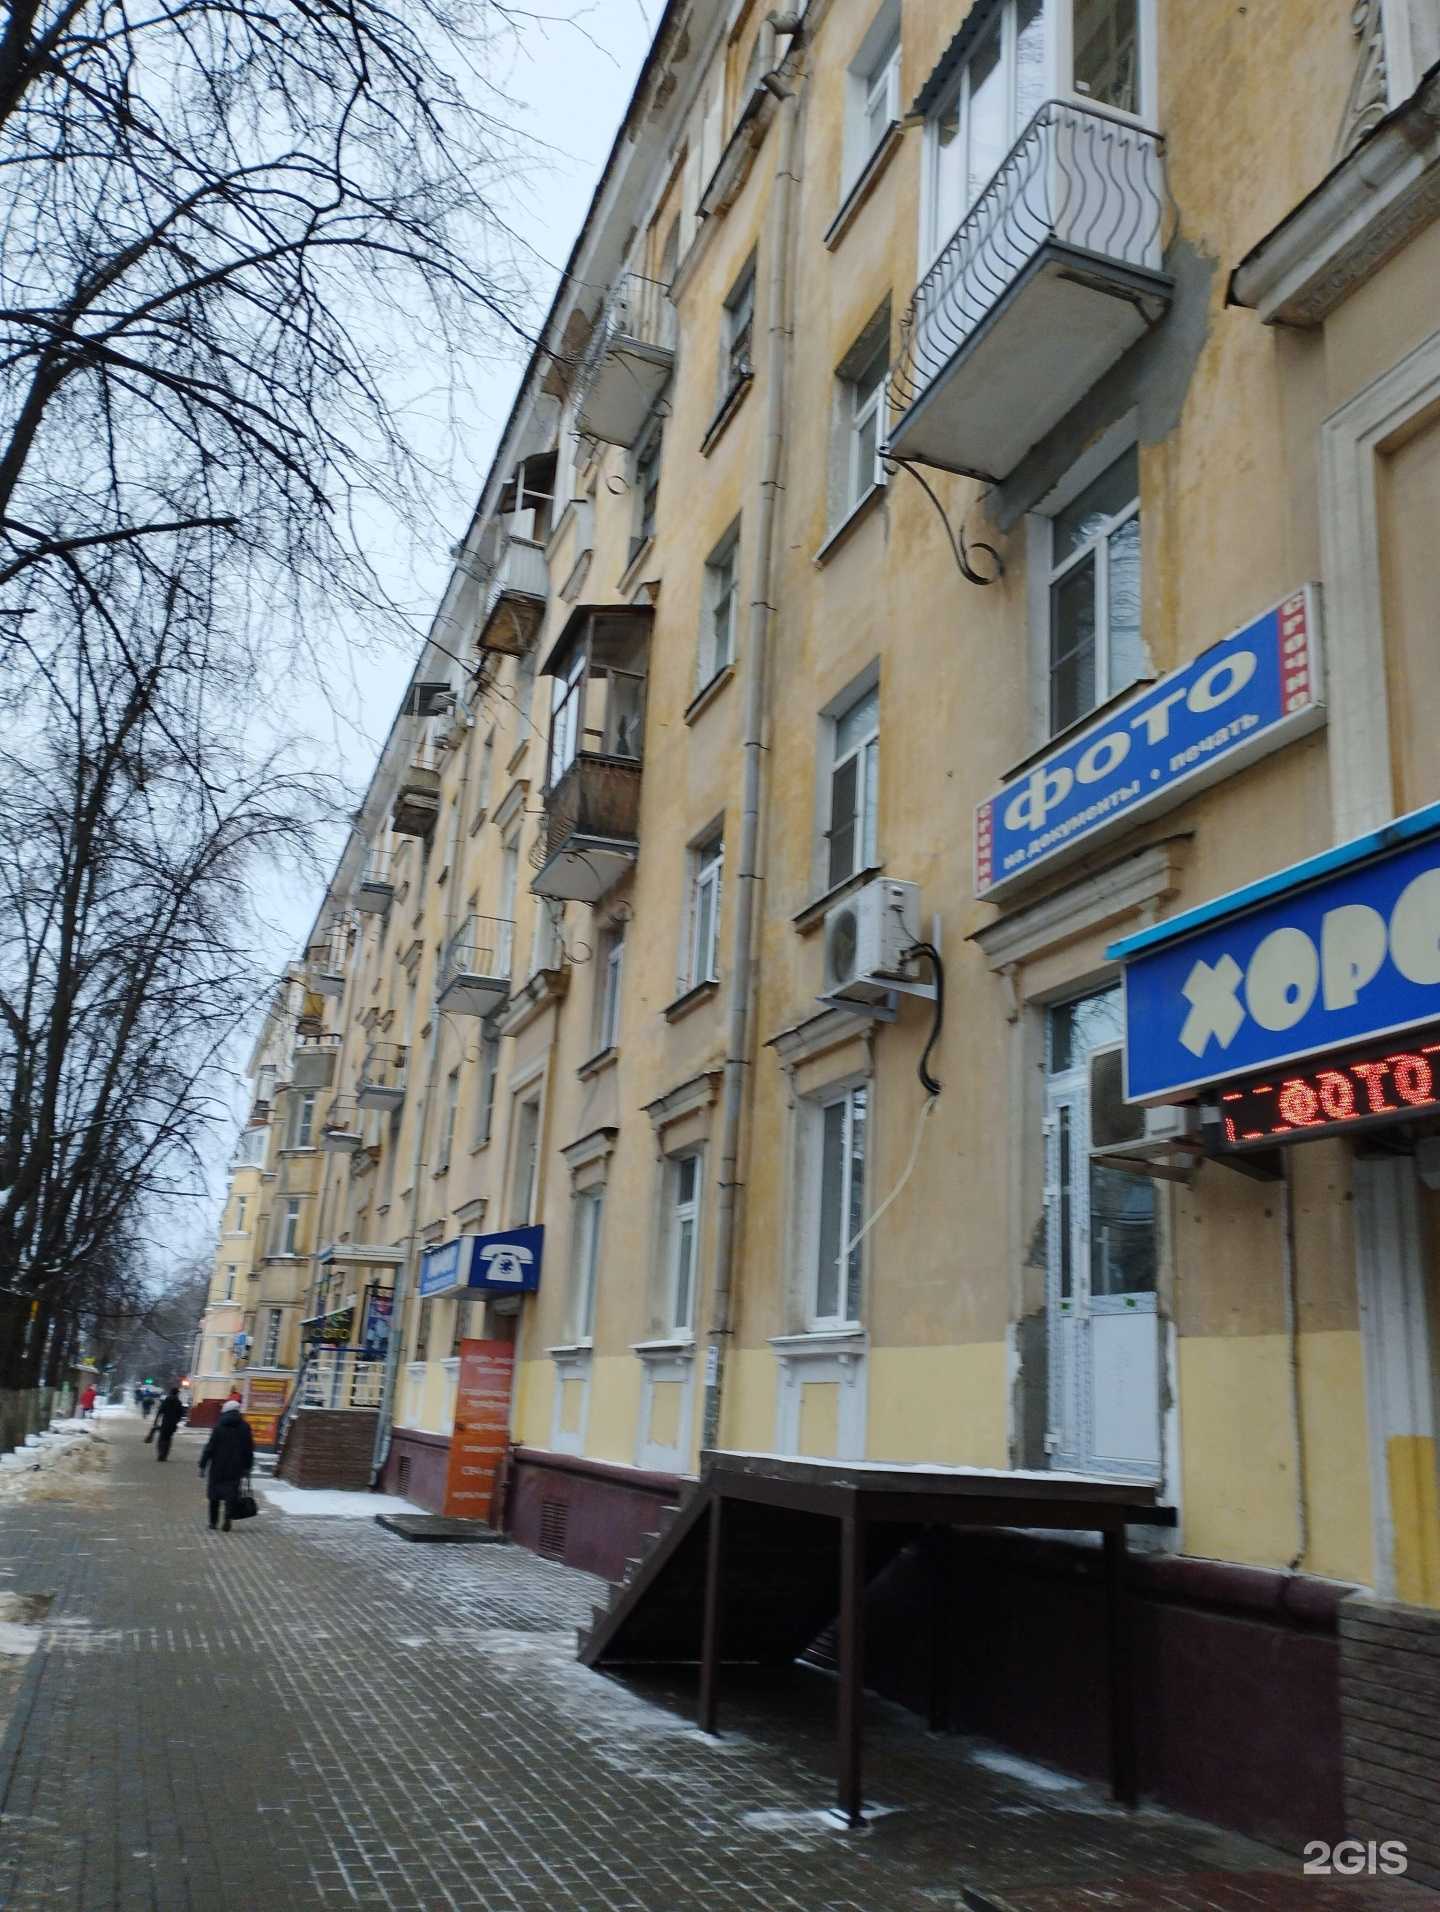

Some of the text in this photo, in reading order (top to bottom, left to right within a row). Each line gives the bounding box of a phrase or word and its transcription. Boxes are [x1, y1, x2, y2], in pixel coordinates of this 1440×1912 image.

[1003, 651, 1256, 831] ФОТО
[1026, 779, 1141, 858] документы
[1169, 713, 1260, 772] печать
